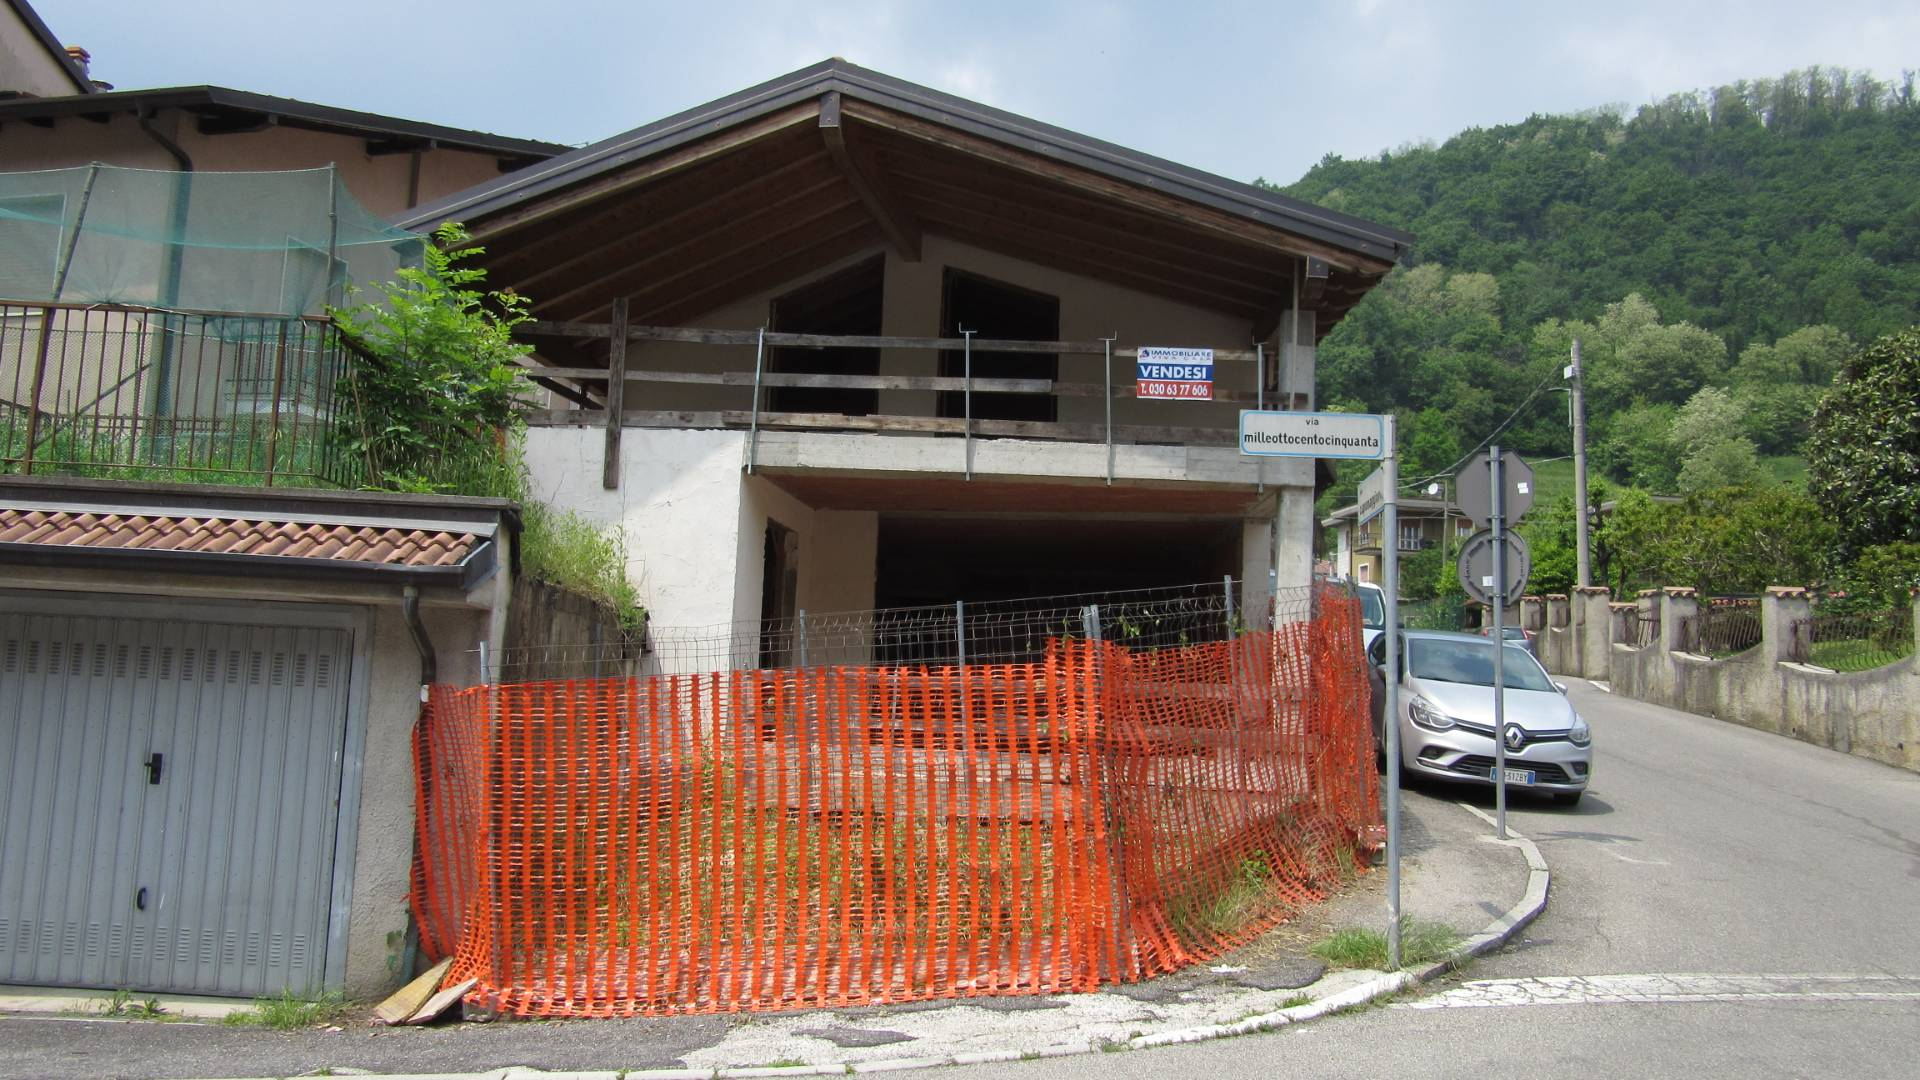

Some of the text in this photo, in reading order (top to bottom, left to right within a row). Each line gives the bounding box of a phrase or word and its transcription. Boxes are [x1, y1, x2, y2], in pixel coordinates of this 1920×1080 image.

[1140, 365, 1207, 379] VENDESI
[1140, 383, 1208, 396] T. 030 63 77 606
[1305, 417, 1319, 426] via
[1244, 431, 1379, 448] milleottocentocinquanta
